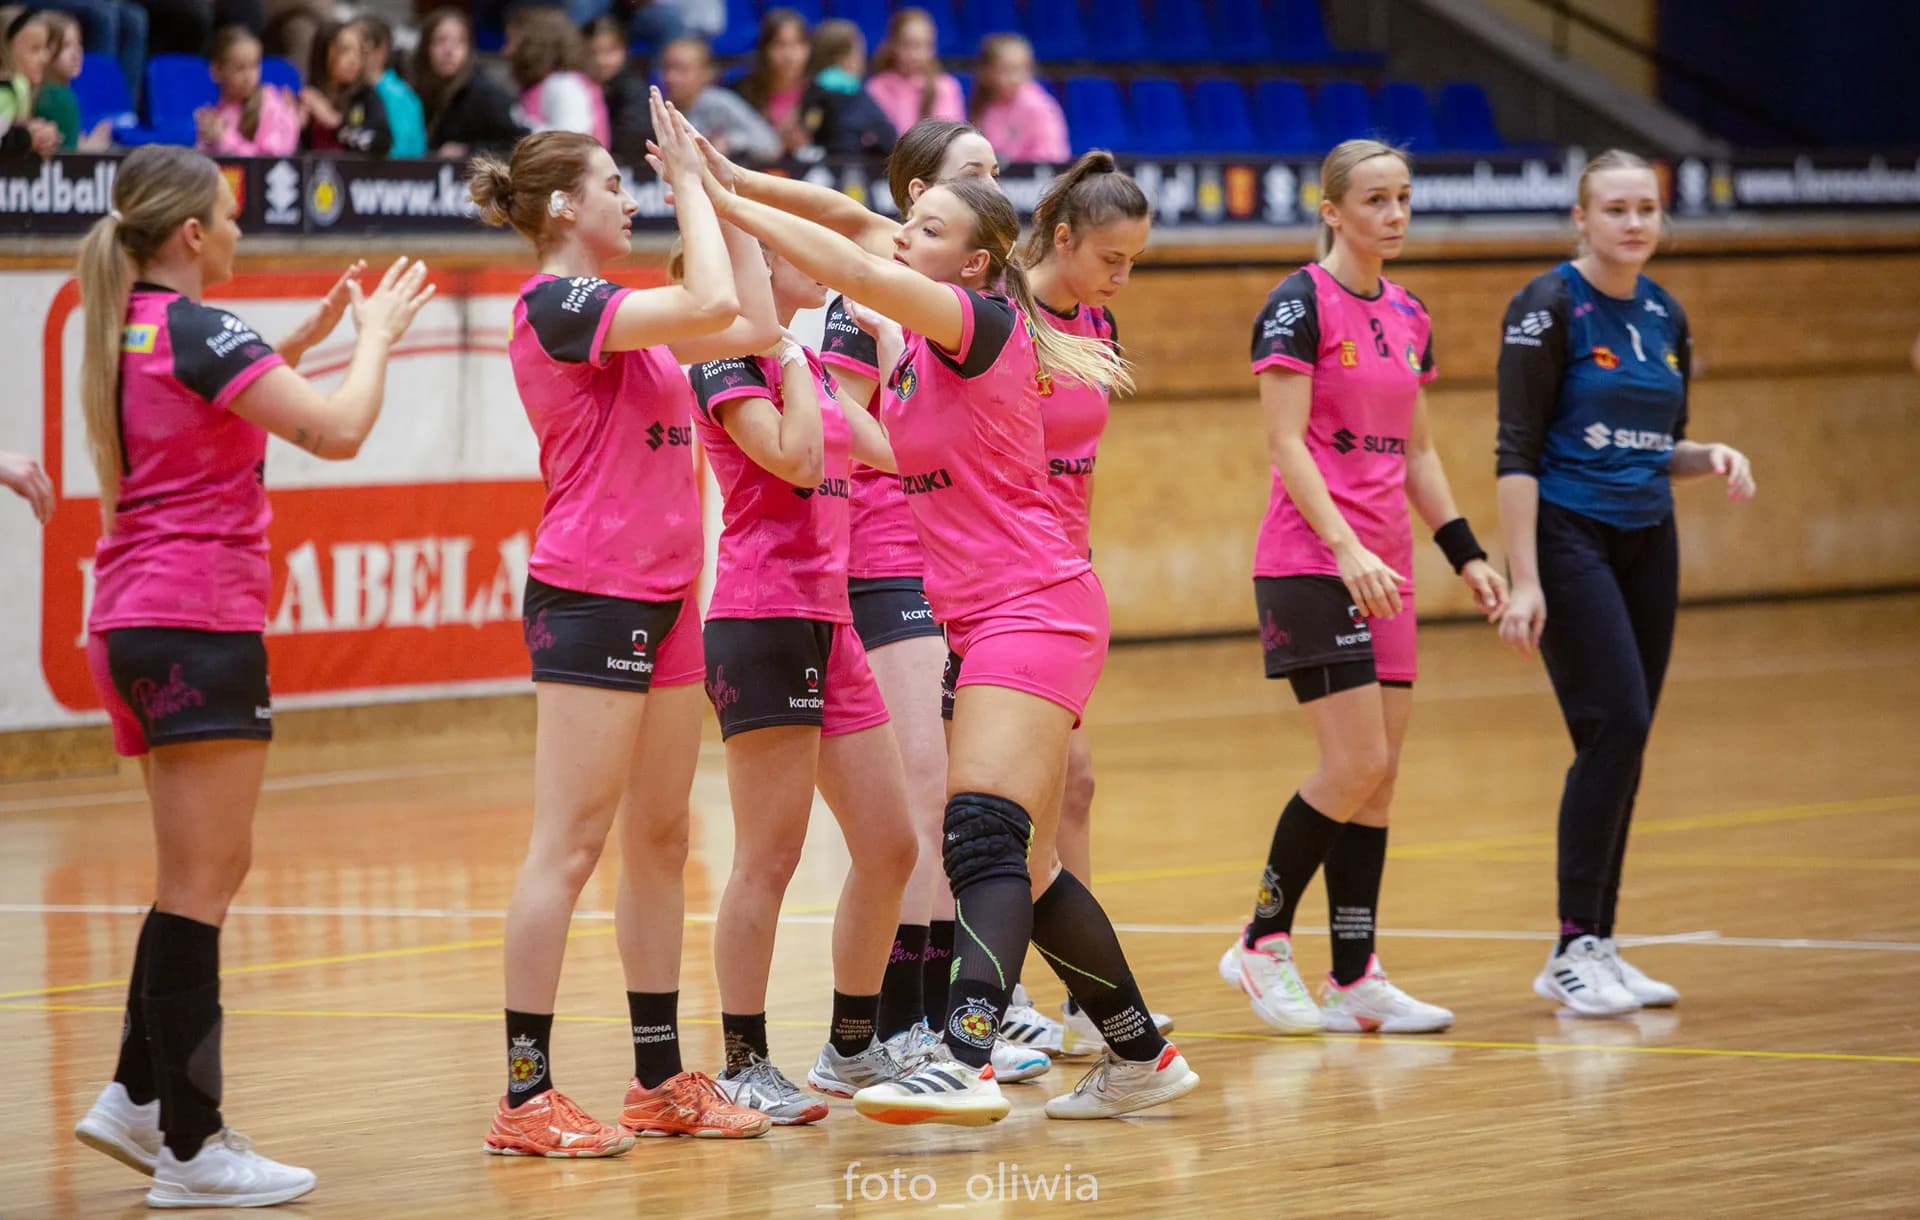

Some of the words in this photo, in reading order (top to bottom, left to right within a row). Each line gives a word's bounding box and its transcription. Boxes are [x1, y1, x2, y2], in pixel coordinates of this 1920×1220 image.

[0, 160, 117, 213] ndball
[1369, 318, 1390, 358] 2
[1625, 322, 1647, 363] 1
[703, 361, 746, 380] Horizon
